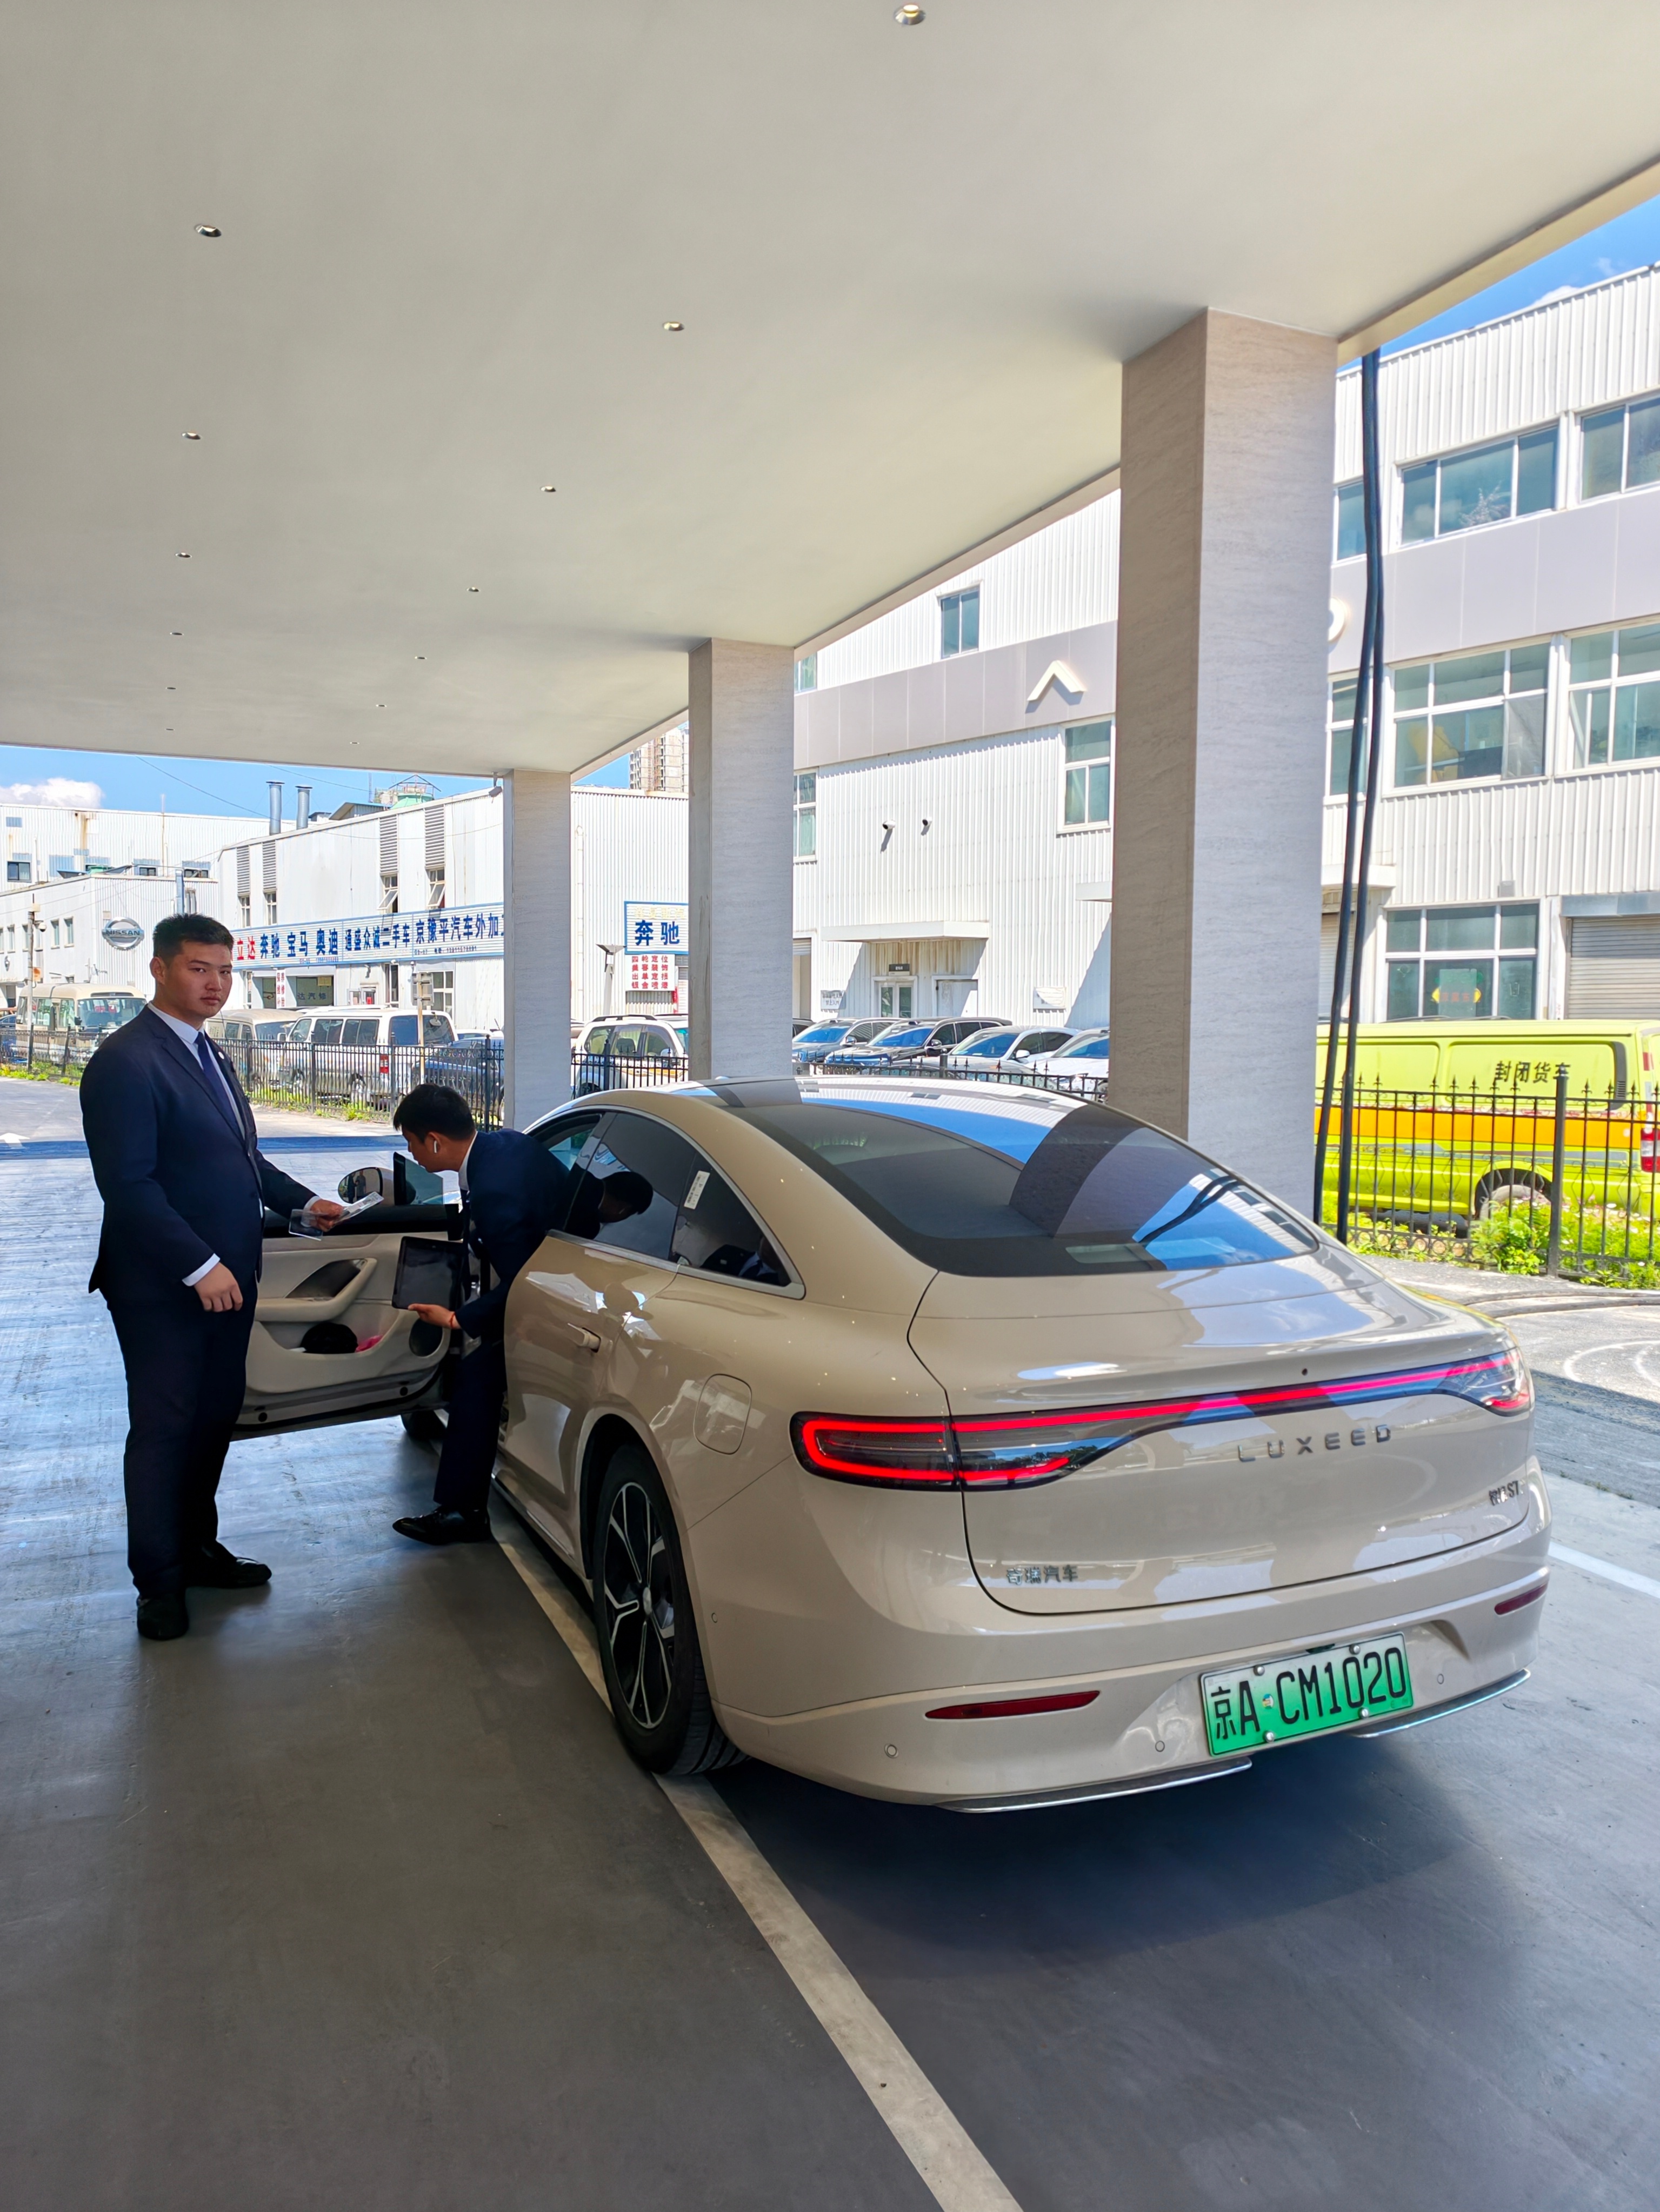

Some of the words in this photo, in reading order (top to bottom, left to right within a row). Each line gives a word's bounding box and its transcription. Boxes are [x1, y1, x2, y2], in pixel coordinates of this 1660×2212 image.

[231, 935, 255, 961] 立达
[260, 933, 280, 959] 奔驰
[287, 932, 308, 957] 宝马
[316, 928, 338, 955] 奥迪
[635, 920, 680, 946] 奔驰
[1494, 1060, 1570, 1083] 封闭货车
[1238, 1424, 1391, 1462] LUXEED
[1006, 1565, 1078, 1585] 奇瑞汽车
